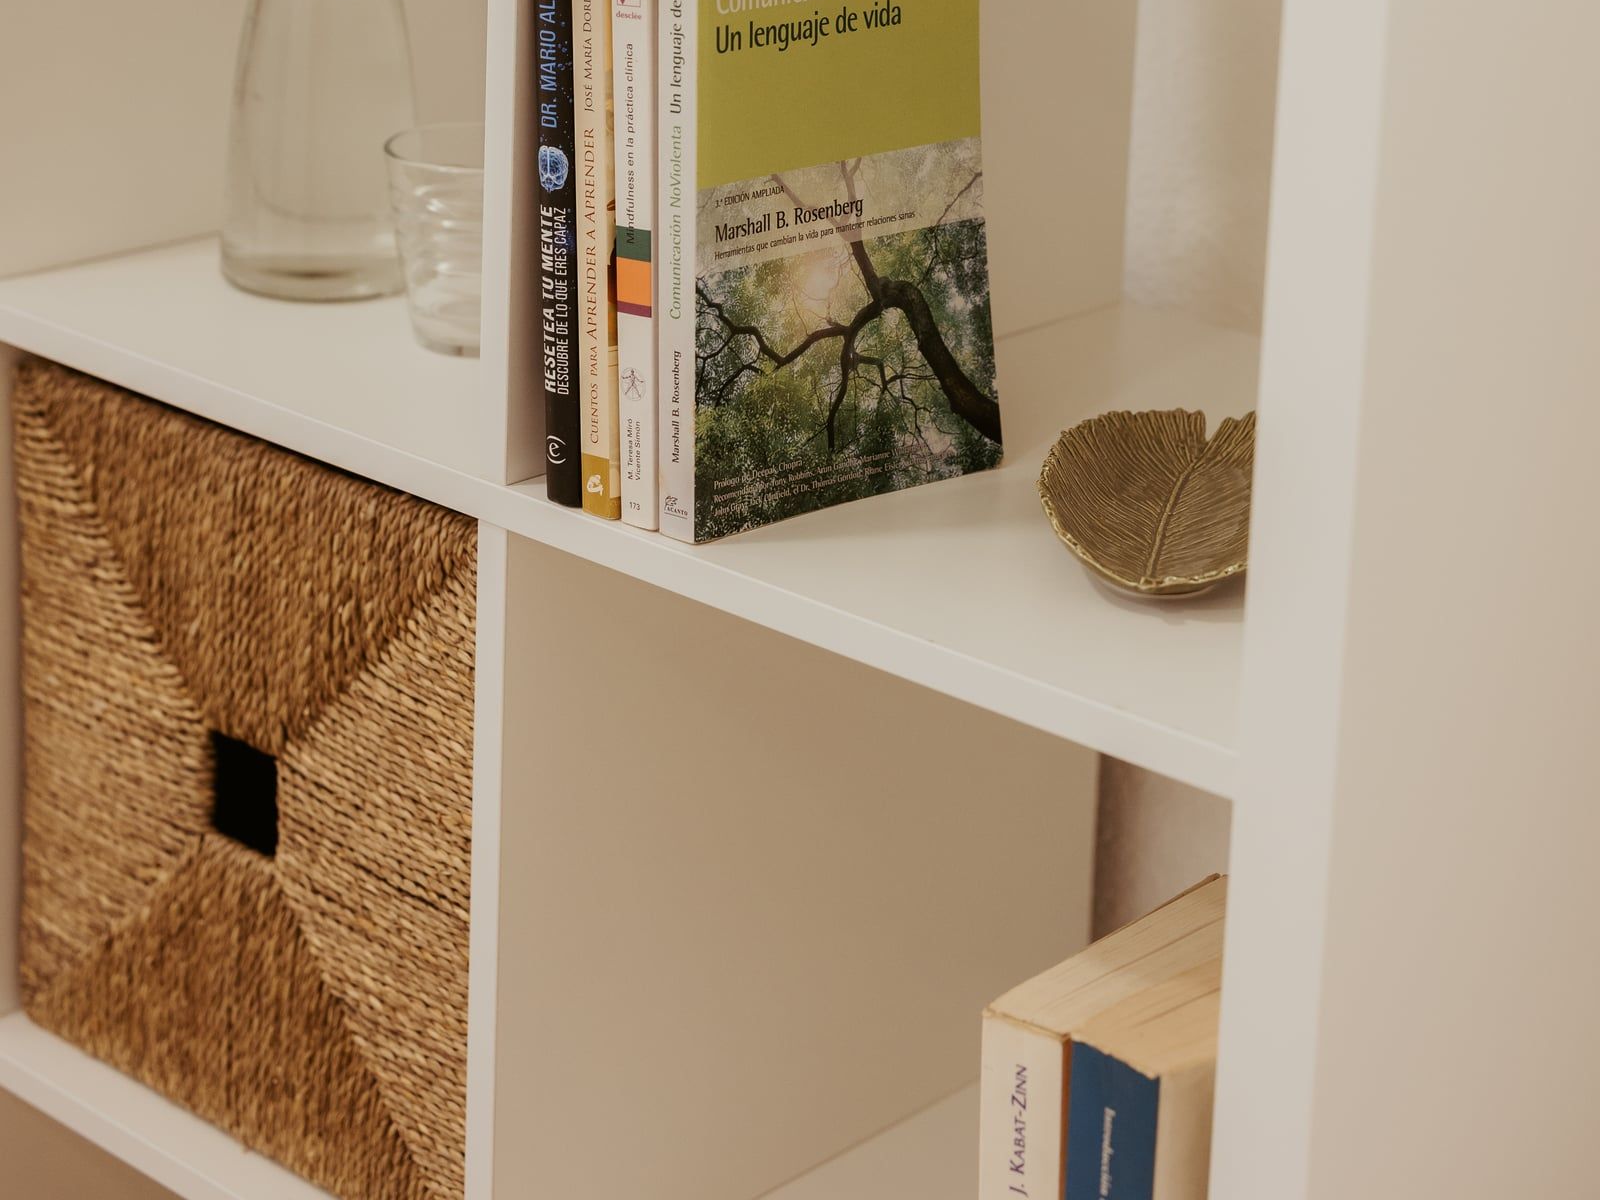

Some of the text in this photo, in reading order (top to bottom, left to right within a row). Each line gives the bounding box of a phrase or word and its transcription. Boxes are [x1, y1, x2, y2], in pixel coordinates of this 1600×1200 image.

[670, 0, 682, 18] de
[716, 0, 902, 54] Un lenguaje de vida
[540, 30, 557, 91] MARIO
[670, 23, 686, 87] lenguaje
[541, 99, 558, 128] DR.
[670, 94, 682, 114] Un
[624, 43, 635, 244] Mindfulness en la práctica clínica
[669, 126, 682, 208] NoViolenta
[584, 128, 595, 223] APRENDER
[751, 185, 785, 200] AMPLIADA
[586, 229, 596, 239] A
[714, 199, 864, 243] Marshall B. Rosenberg
[714, 210, 916, 261] Herramientas que cambian la vida para mantener relaciones sanas
[586, 246, 598, 339] APRENDER
[669, 214, 682, 320] Comunicación
[541, 205, 556, 393] RESETEA TU MENTE
[554, 208, 569, 395] DESCUBRE DE LO QUE ERES CAPAZ
[633, 421, 641, 448] Simón
[671, 350, 682, 464] Marshall B. Rosenberg
[629, 501, 641, 511] 173
[1009, 1064, 1030, 1198] J. KABAT-ZINN
